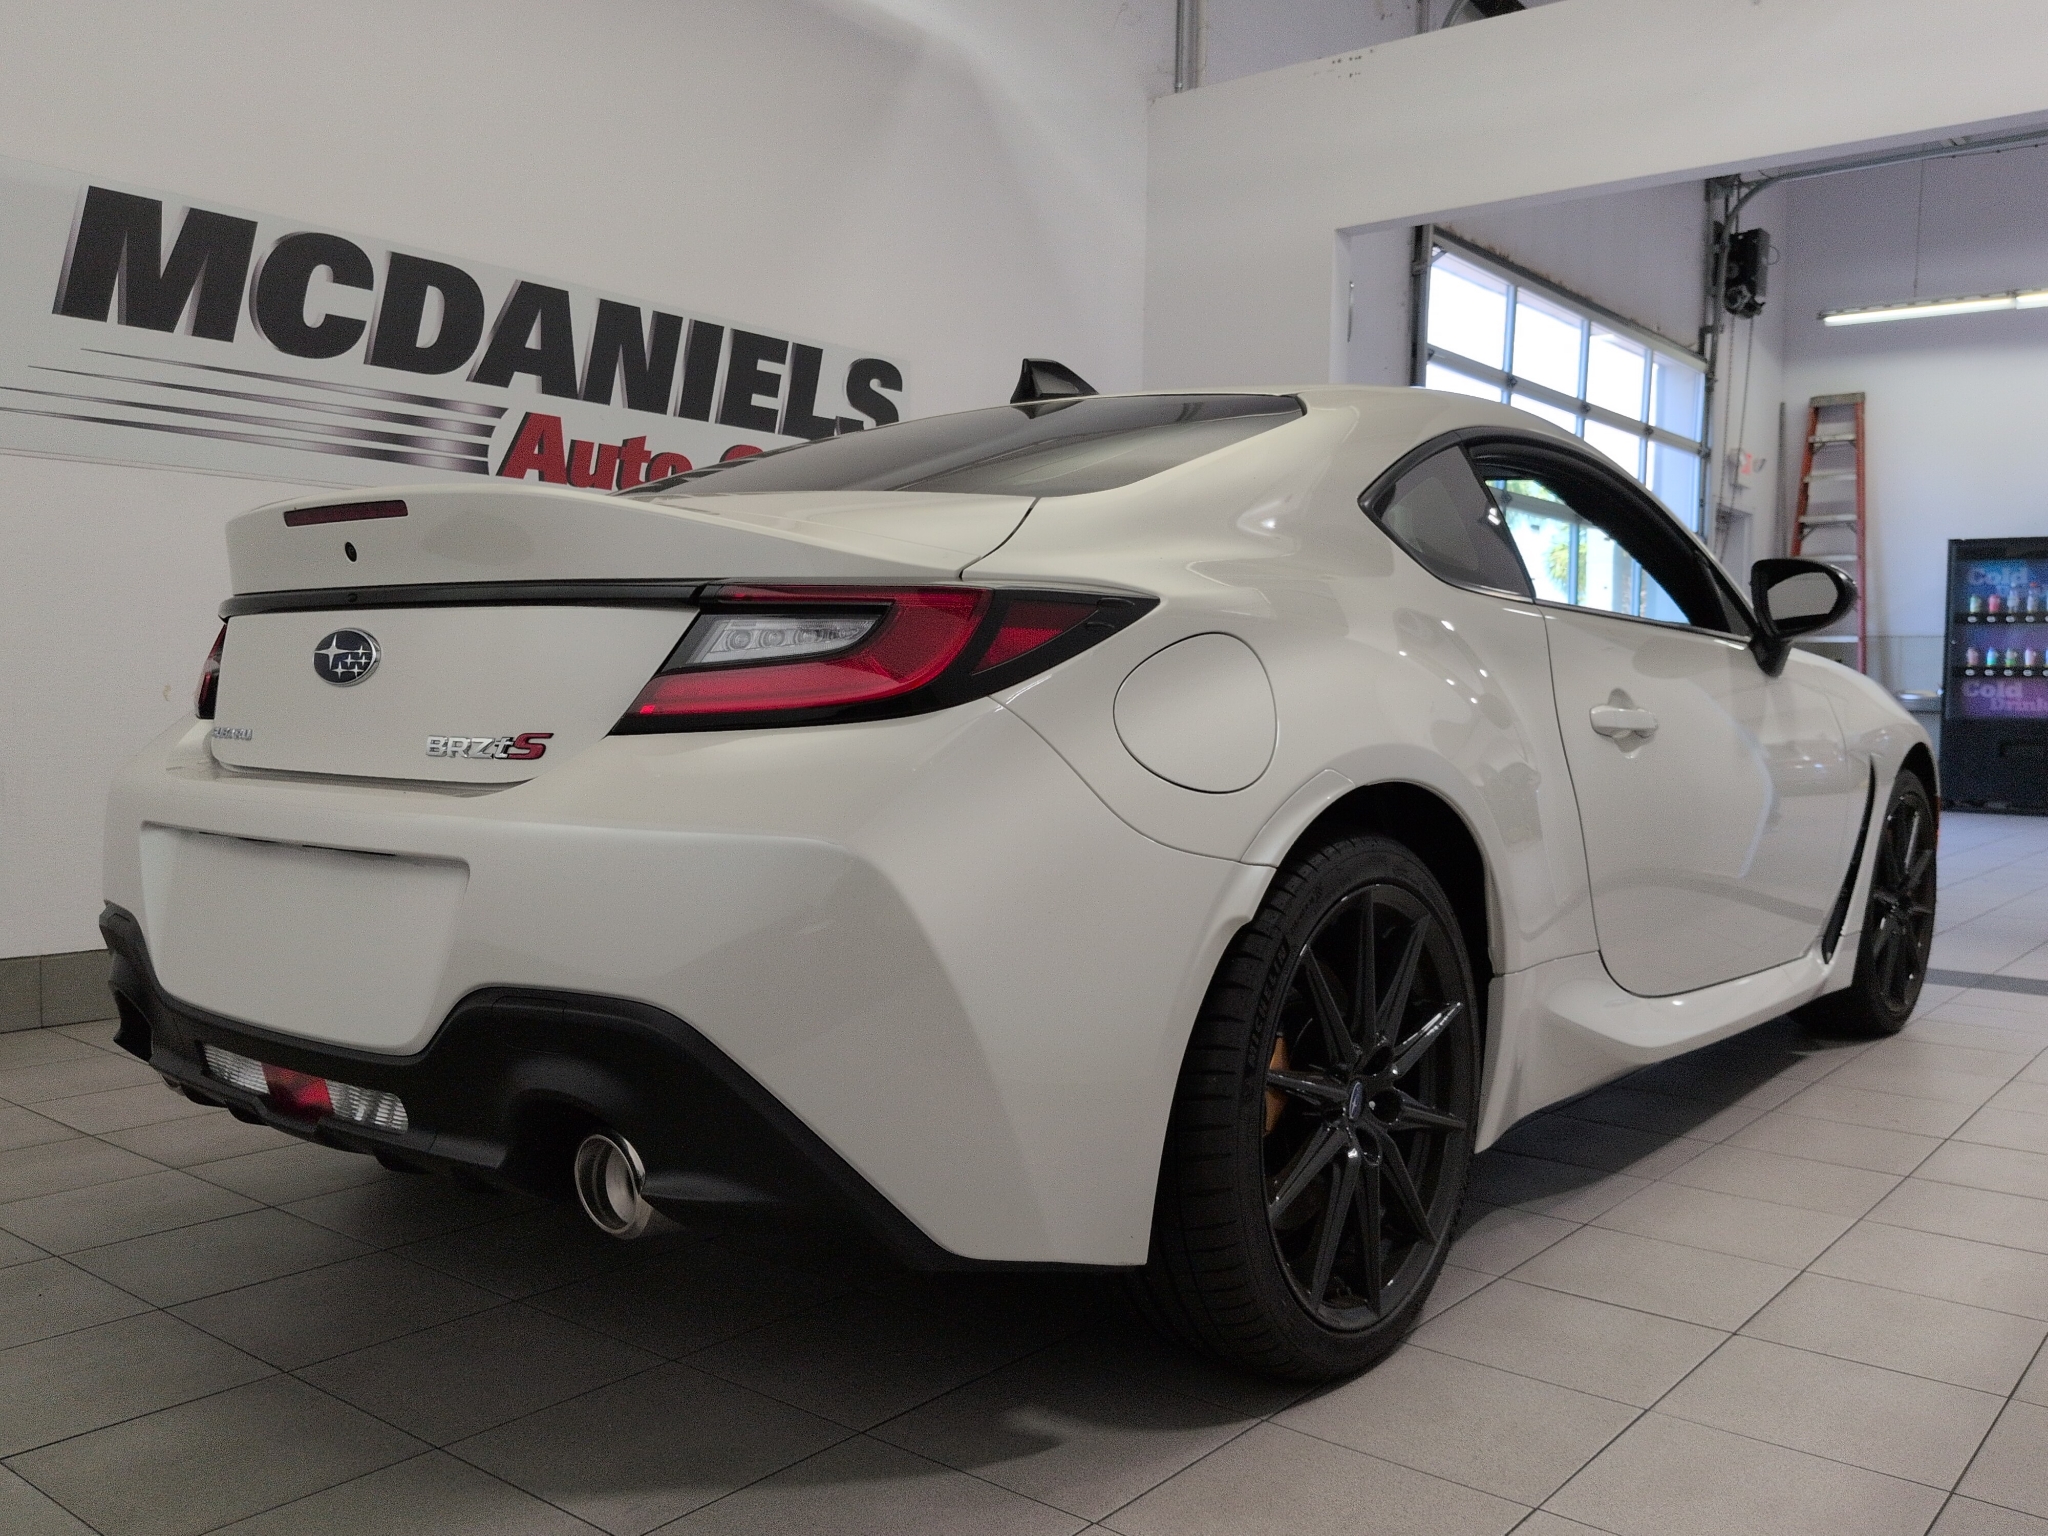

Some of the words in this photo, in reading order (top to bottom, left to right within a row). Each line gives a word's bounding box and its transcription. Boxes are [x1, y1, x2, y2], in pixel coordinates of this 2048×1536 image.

[52, 185, 902, 440] MCDANIELS
[495, 411, 692, 491] Auto
[1968, 566, 2028, 585] Cold
[1961, 680, 2023, 697] Cold
